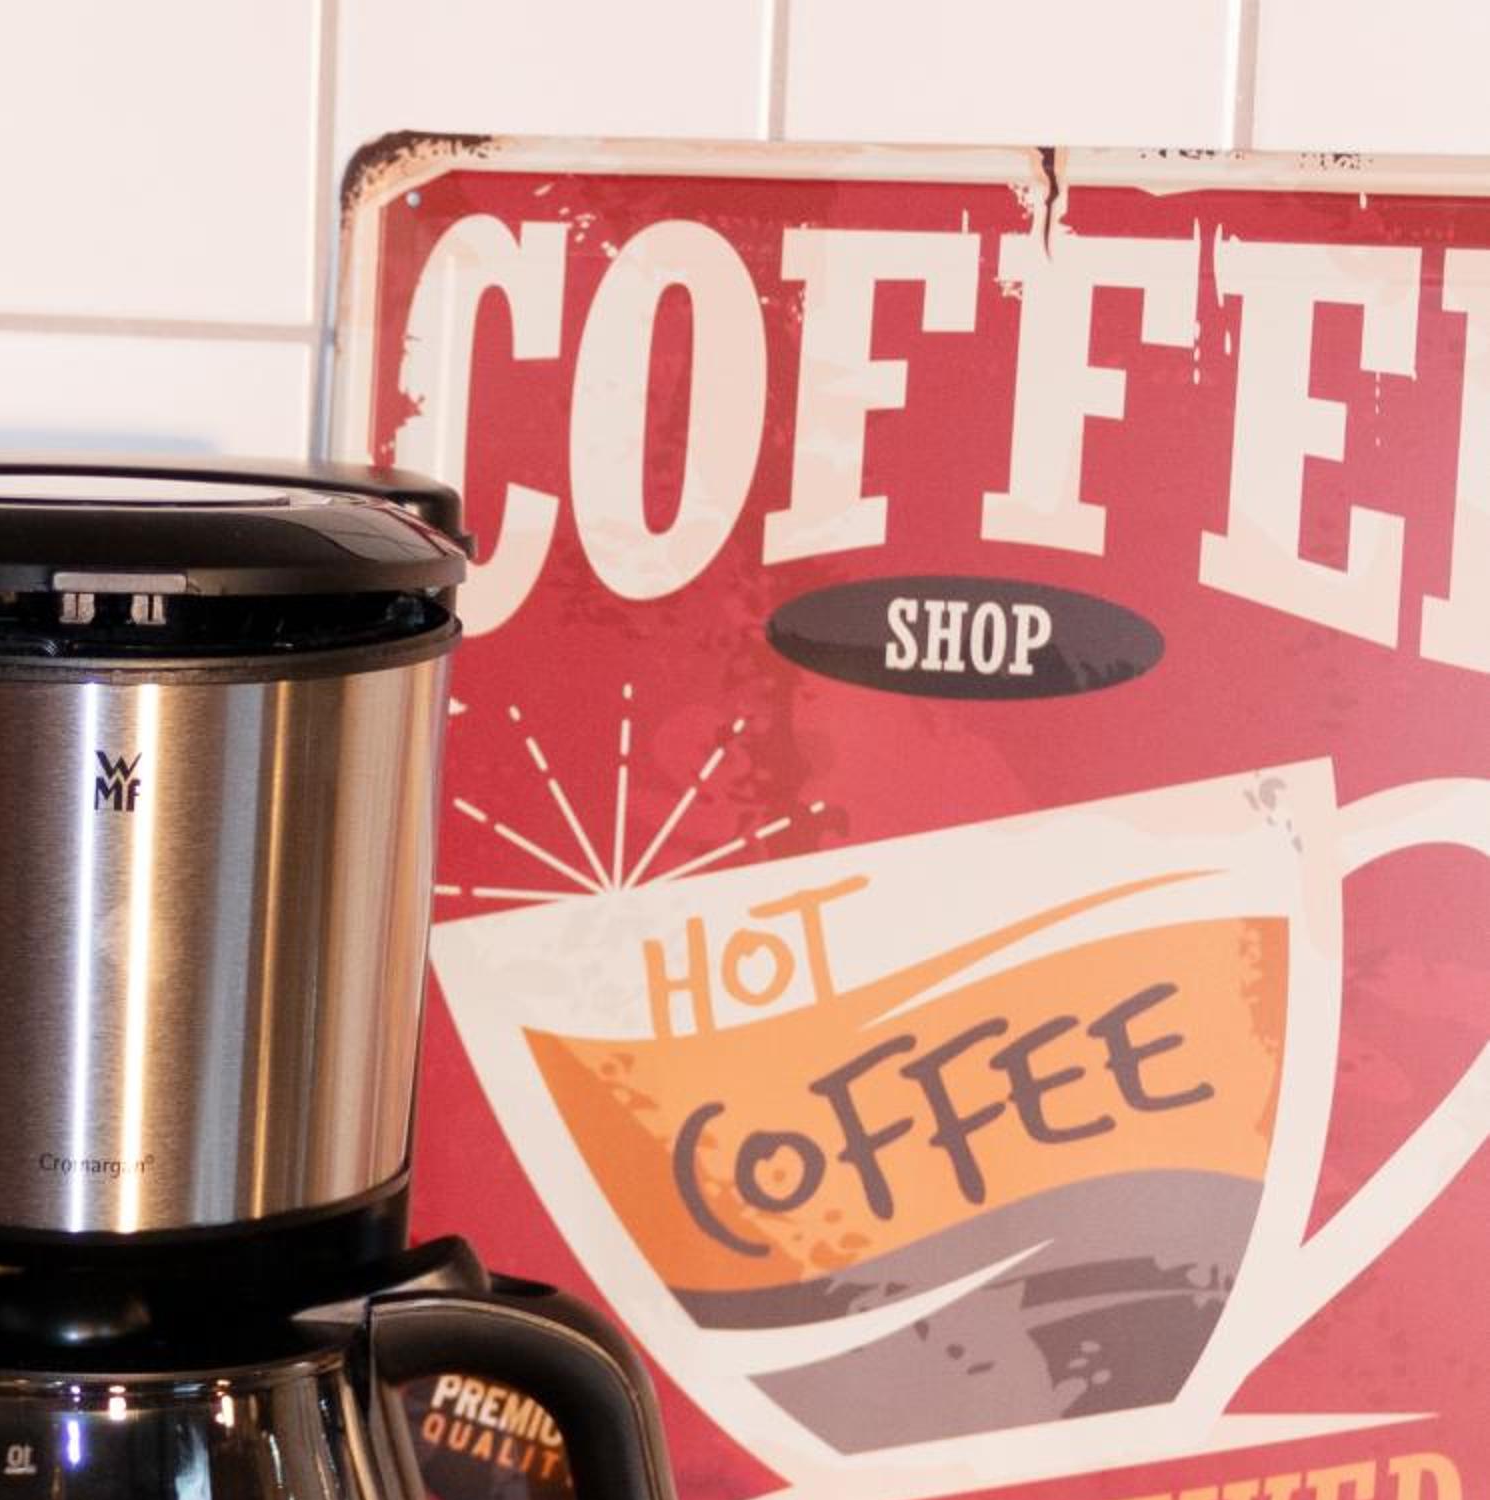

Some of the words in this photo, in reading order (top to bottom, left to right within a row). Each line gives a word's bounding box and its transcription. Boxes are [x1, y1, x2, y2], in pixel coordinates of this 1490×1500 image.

[884, 598, 1052, 676] SHOP
[642, 874, 870, 1040] HOT
[674, 982, 1214, 1256] COFFEE
[431, 1374, 564, 1446] PREMIU
[422, 1412, 574, 1488] QUALIT
